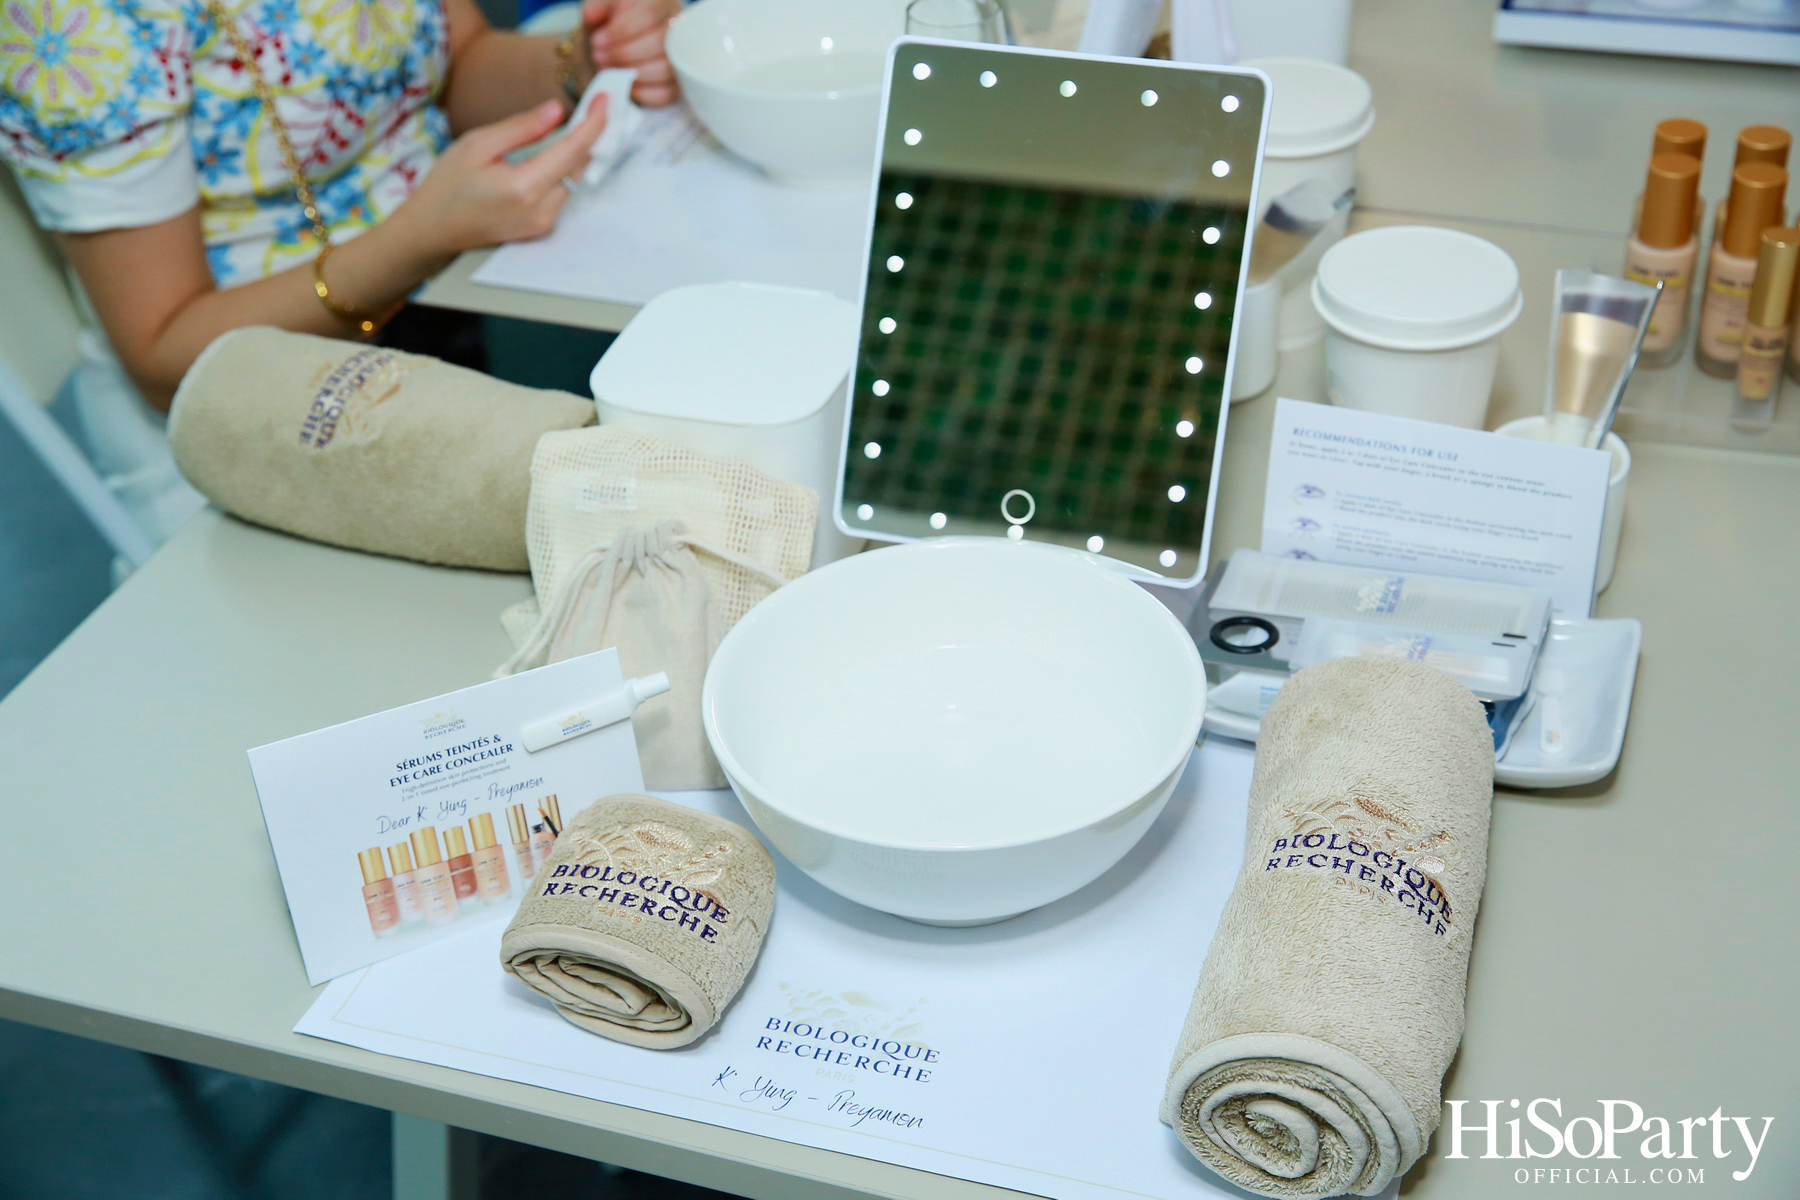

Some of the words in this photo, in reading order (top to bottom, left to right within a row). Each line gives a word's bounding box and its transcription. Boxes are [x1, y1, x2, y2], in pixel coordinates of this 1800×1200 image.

[1292, 427, 1407, 452] RECOMMENDATIONS
[1410, 446, 1434, 458] FOR
[1437, 451, 1458, 462] USE
[423, 718, 465, 735] BIOLOGIQUE
[424, 724, 467, 740] RECHERCHE
[389, 773, 411, 788] EYE
[413, 766, 442, 781] CARE
[445, 743, 513, 770] CONCEALER
[396, 751, 443, 773] SÉRUMS
[445, 736, 490, 758] TEINTÉS
[493, 734, 502, 745] &
[376, 813, 411, 835] Dear
[550, 864, 731, 924] BIOLOGIQUE
[1265, 853, 1447, 936] RECHERCHE
[1272, 833, 1454, 924] BIOLOGIQUE
[542, 882, 719, 944] RECHERCHE
[756, 1036, 933, 1084] RECHERCHE
[765, 1017, 941, 1064] BIOLOGIQUE
[815, 1067, 855, 1084] PARIS
